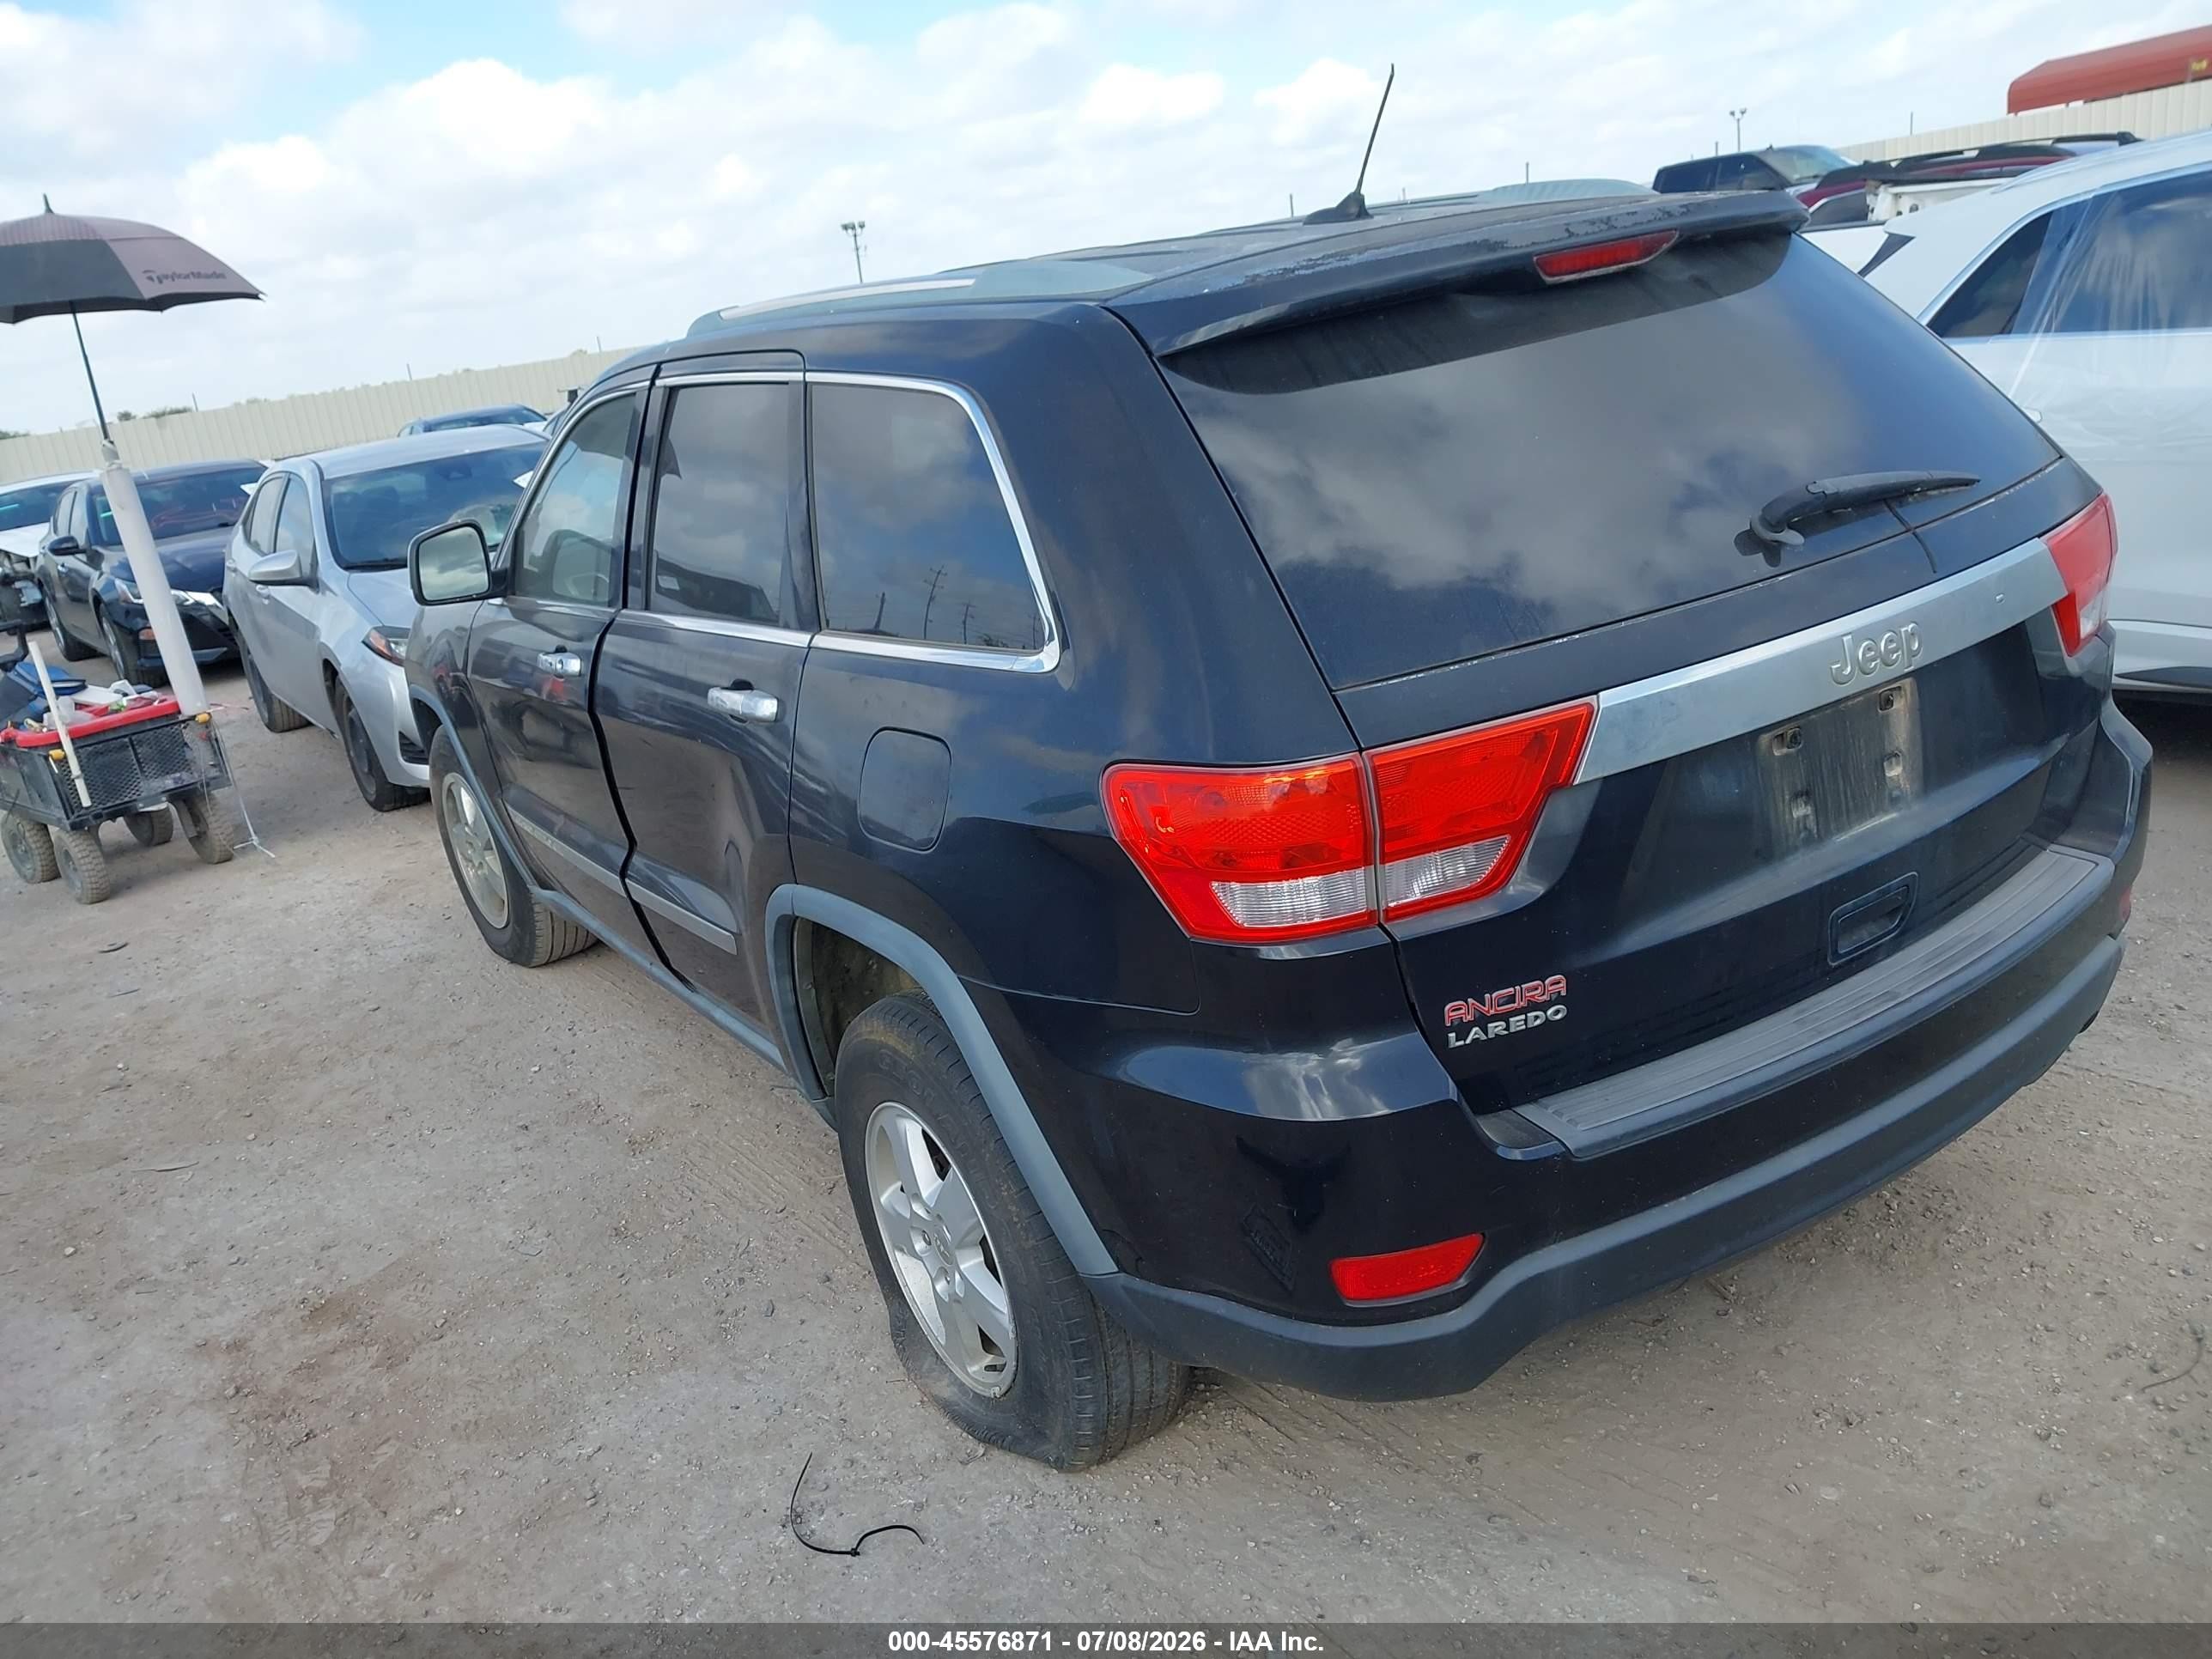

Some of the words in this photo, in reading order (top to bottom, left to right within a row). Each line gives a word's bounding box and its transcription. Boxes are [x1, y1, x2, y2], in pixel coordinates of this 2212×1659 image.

[141, 268, 228, 284] TaylorMade
[1830, 621, 1923, 686] Jeep
[1443, 974, 1567, 1027] ANCIRA
[1447, 1004, 1568, 1049] LAREDO
